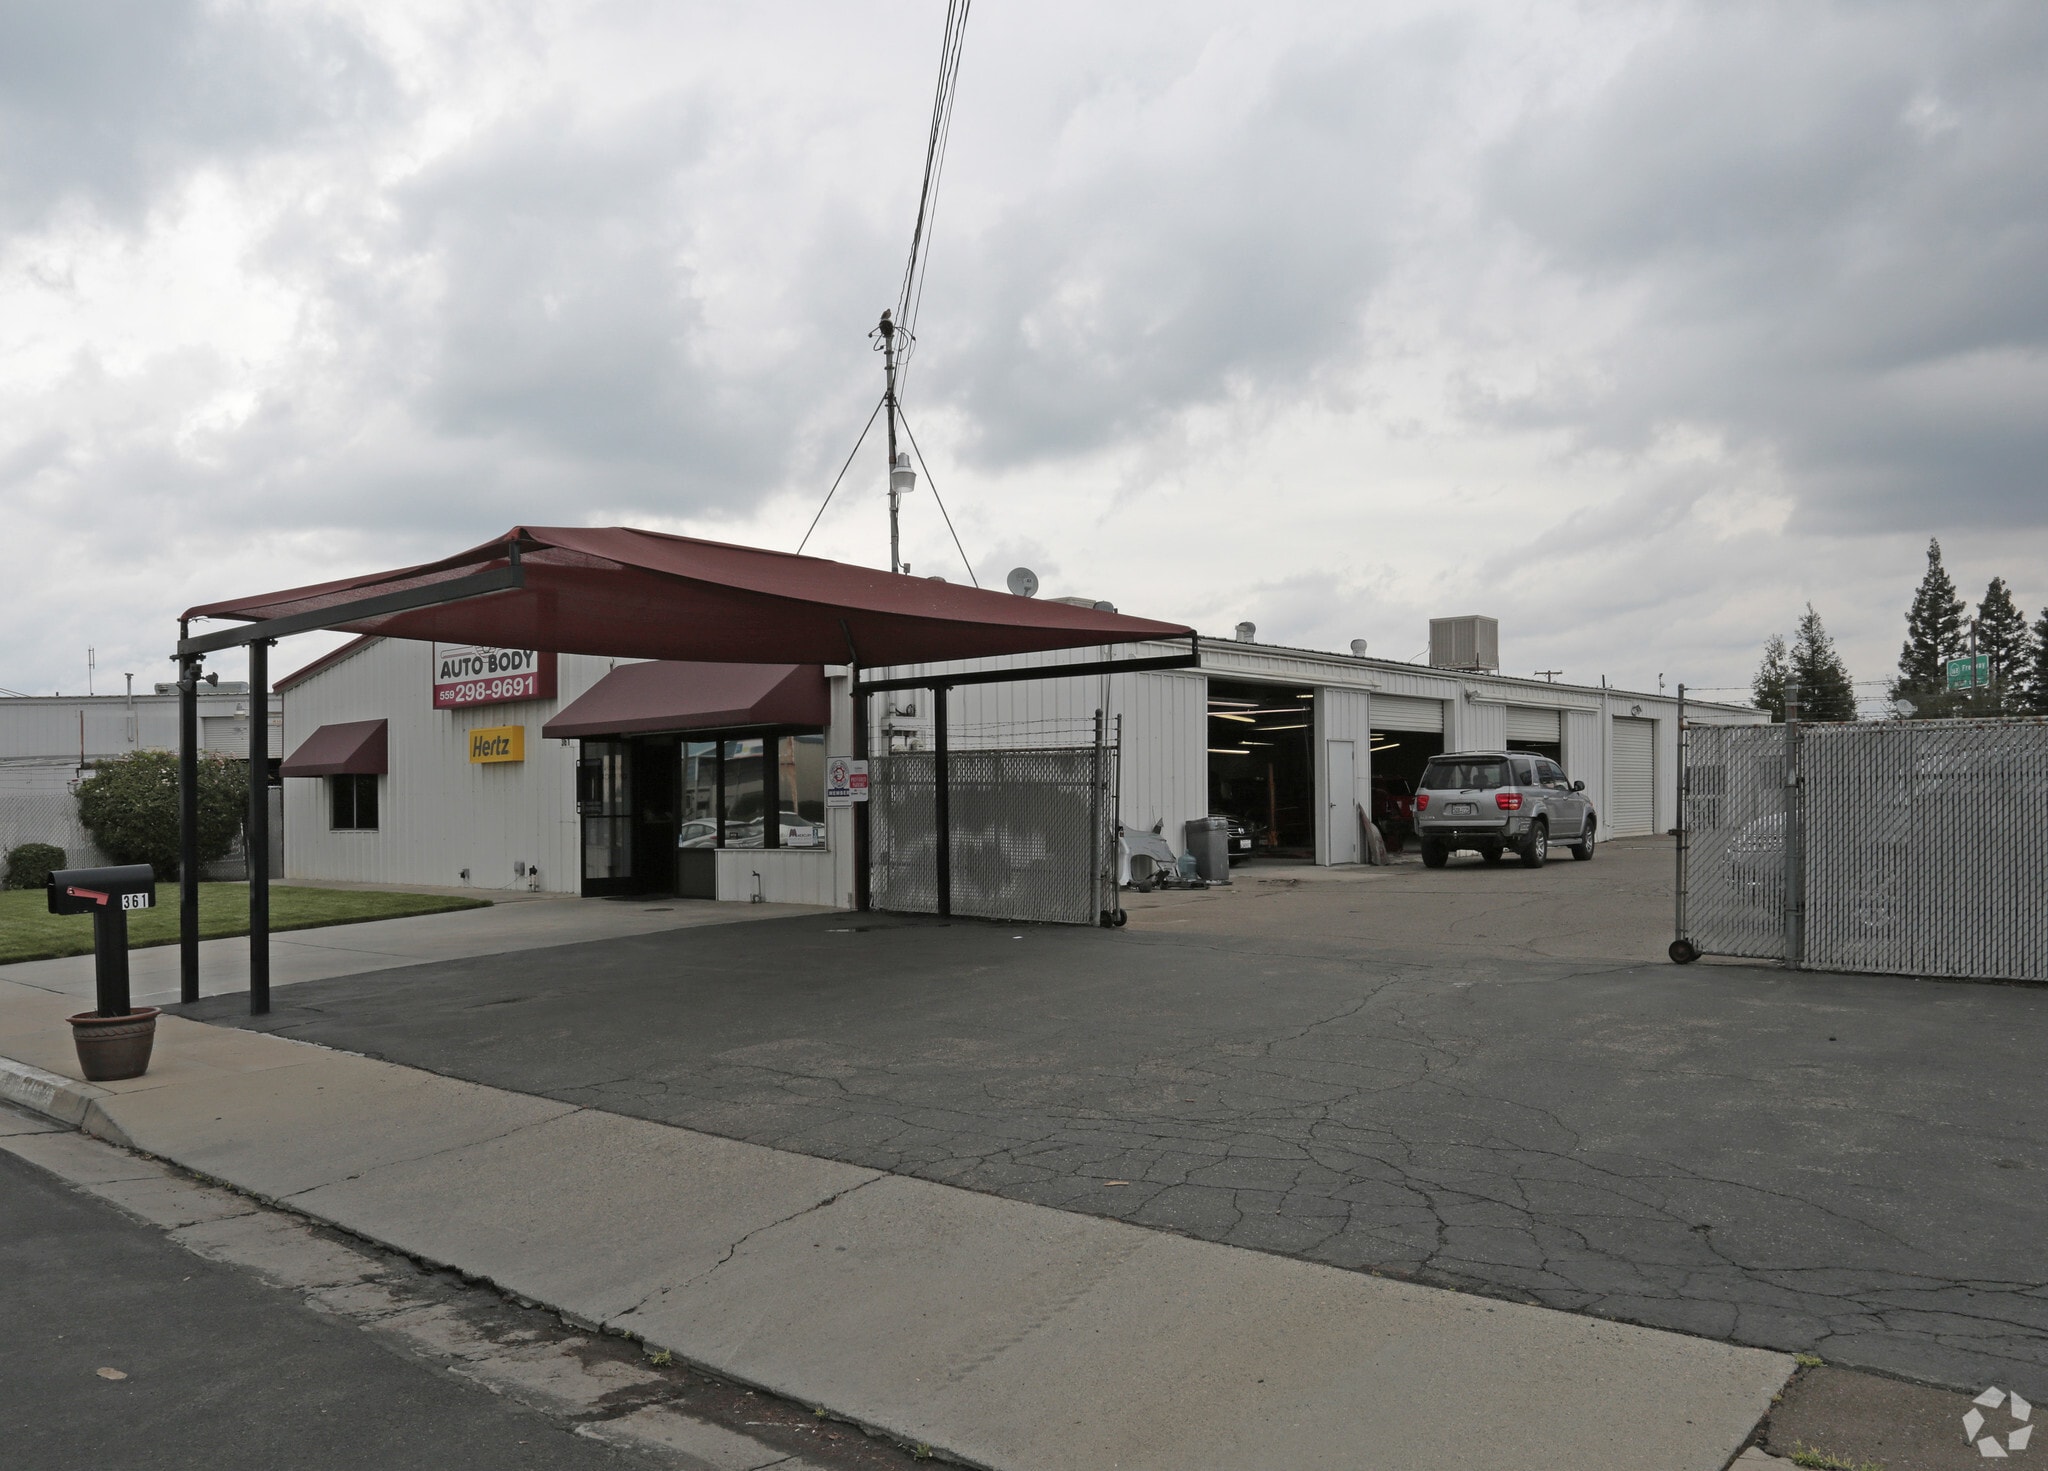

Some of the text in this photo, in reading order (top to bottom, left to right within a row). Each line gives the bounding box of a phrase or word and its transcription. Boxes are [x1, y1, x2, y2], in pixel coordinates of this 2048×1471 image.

[440, 650, 534, 679] AUTO BODY
[439, 676, 534, 702] 559 298-9691
[473, 736, 509, 757] Hertz
[124, 894, 146, 908] 361
